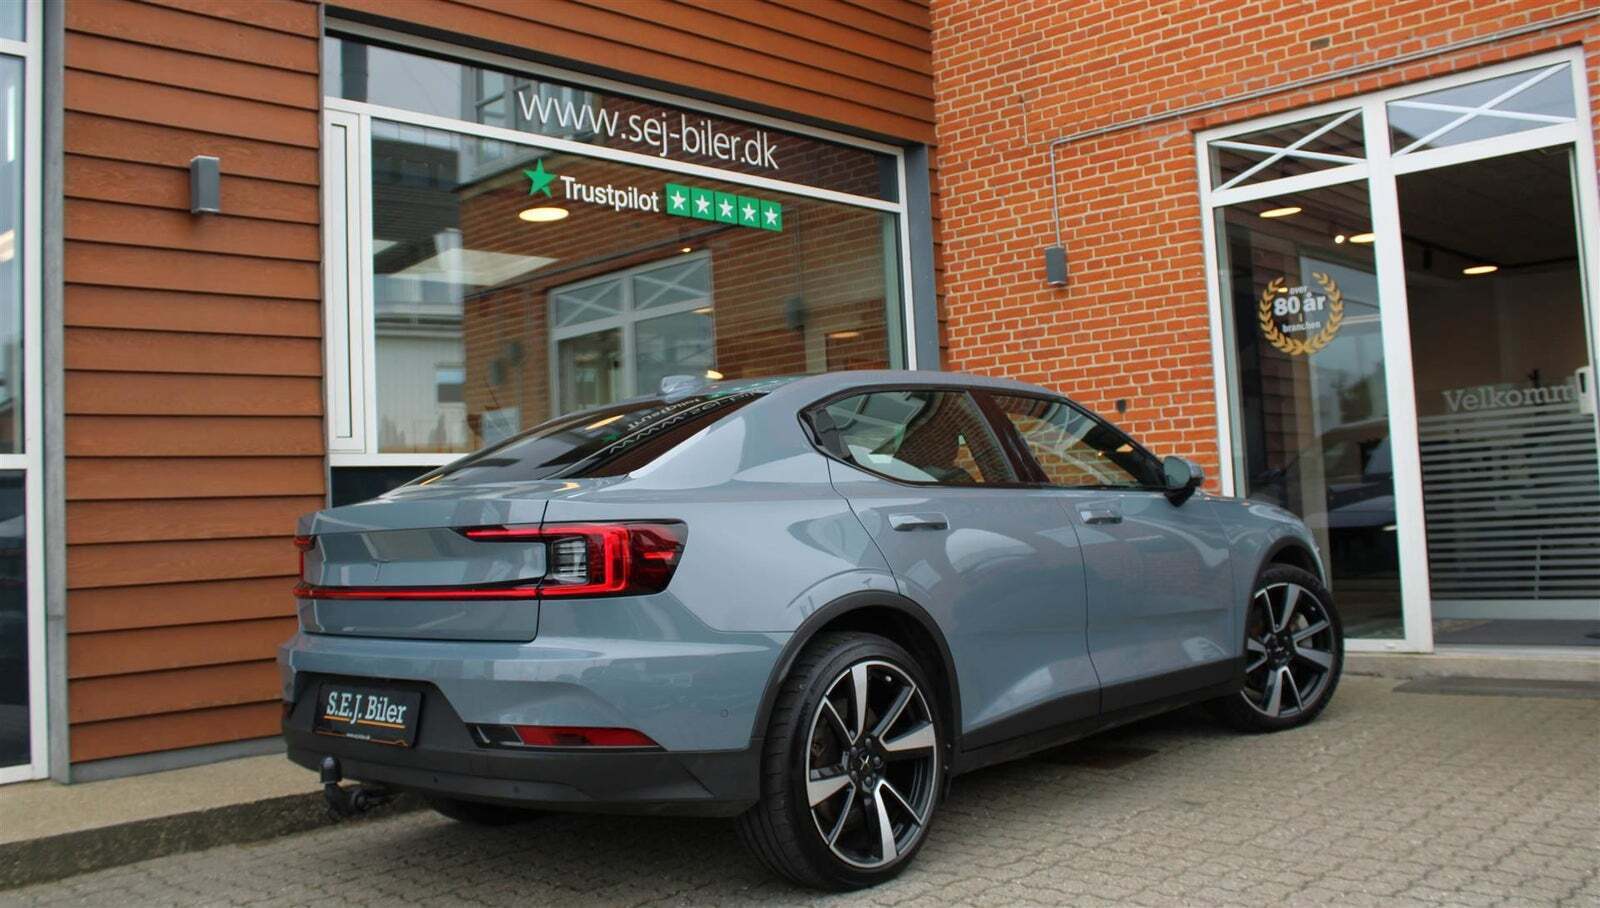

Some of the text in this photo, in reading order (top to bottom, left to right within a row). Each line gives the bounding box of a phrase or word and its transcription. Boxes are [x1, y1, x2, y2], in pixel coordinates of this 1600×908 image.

[518, 91, 779, 170] www.sej-biler.dk
[560, 175, 660, 212] Trustpilot
[1273, 292, 1326, 316] 80 år
[326, 690, 407, 724] S.E.J. Biler
